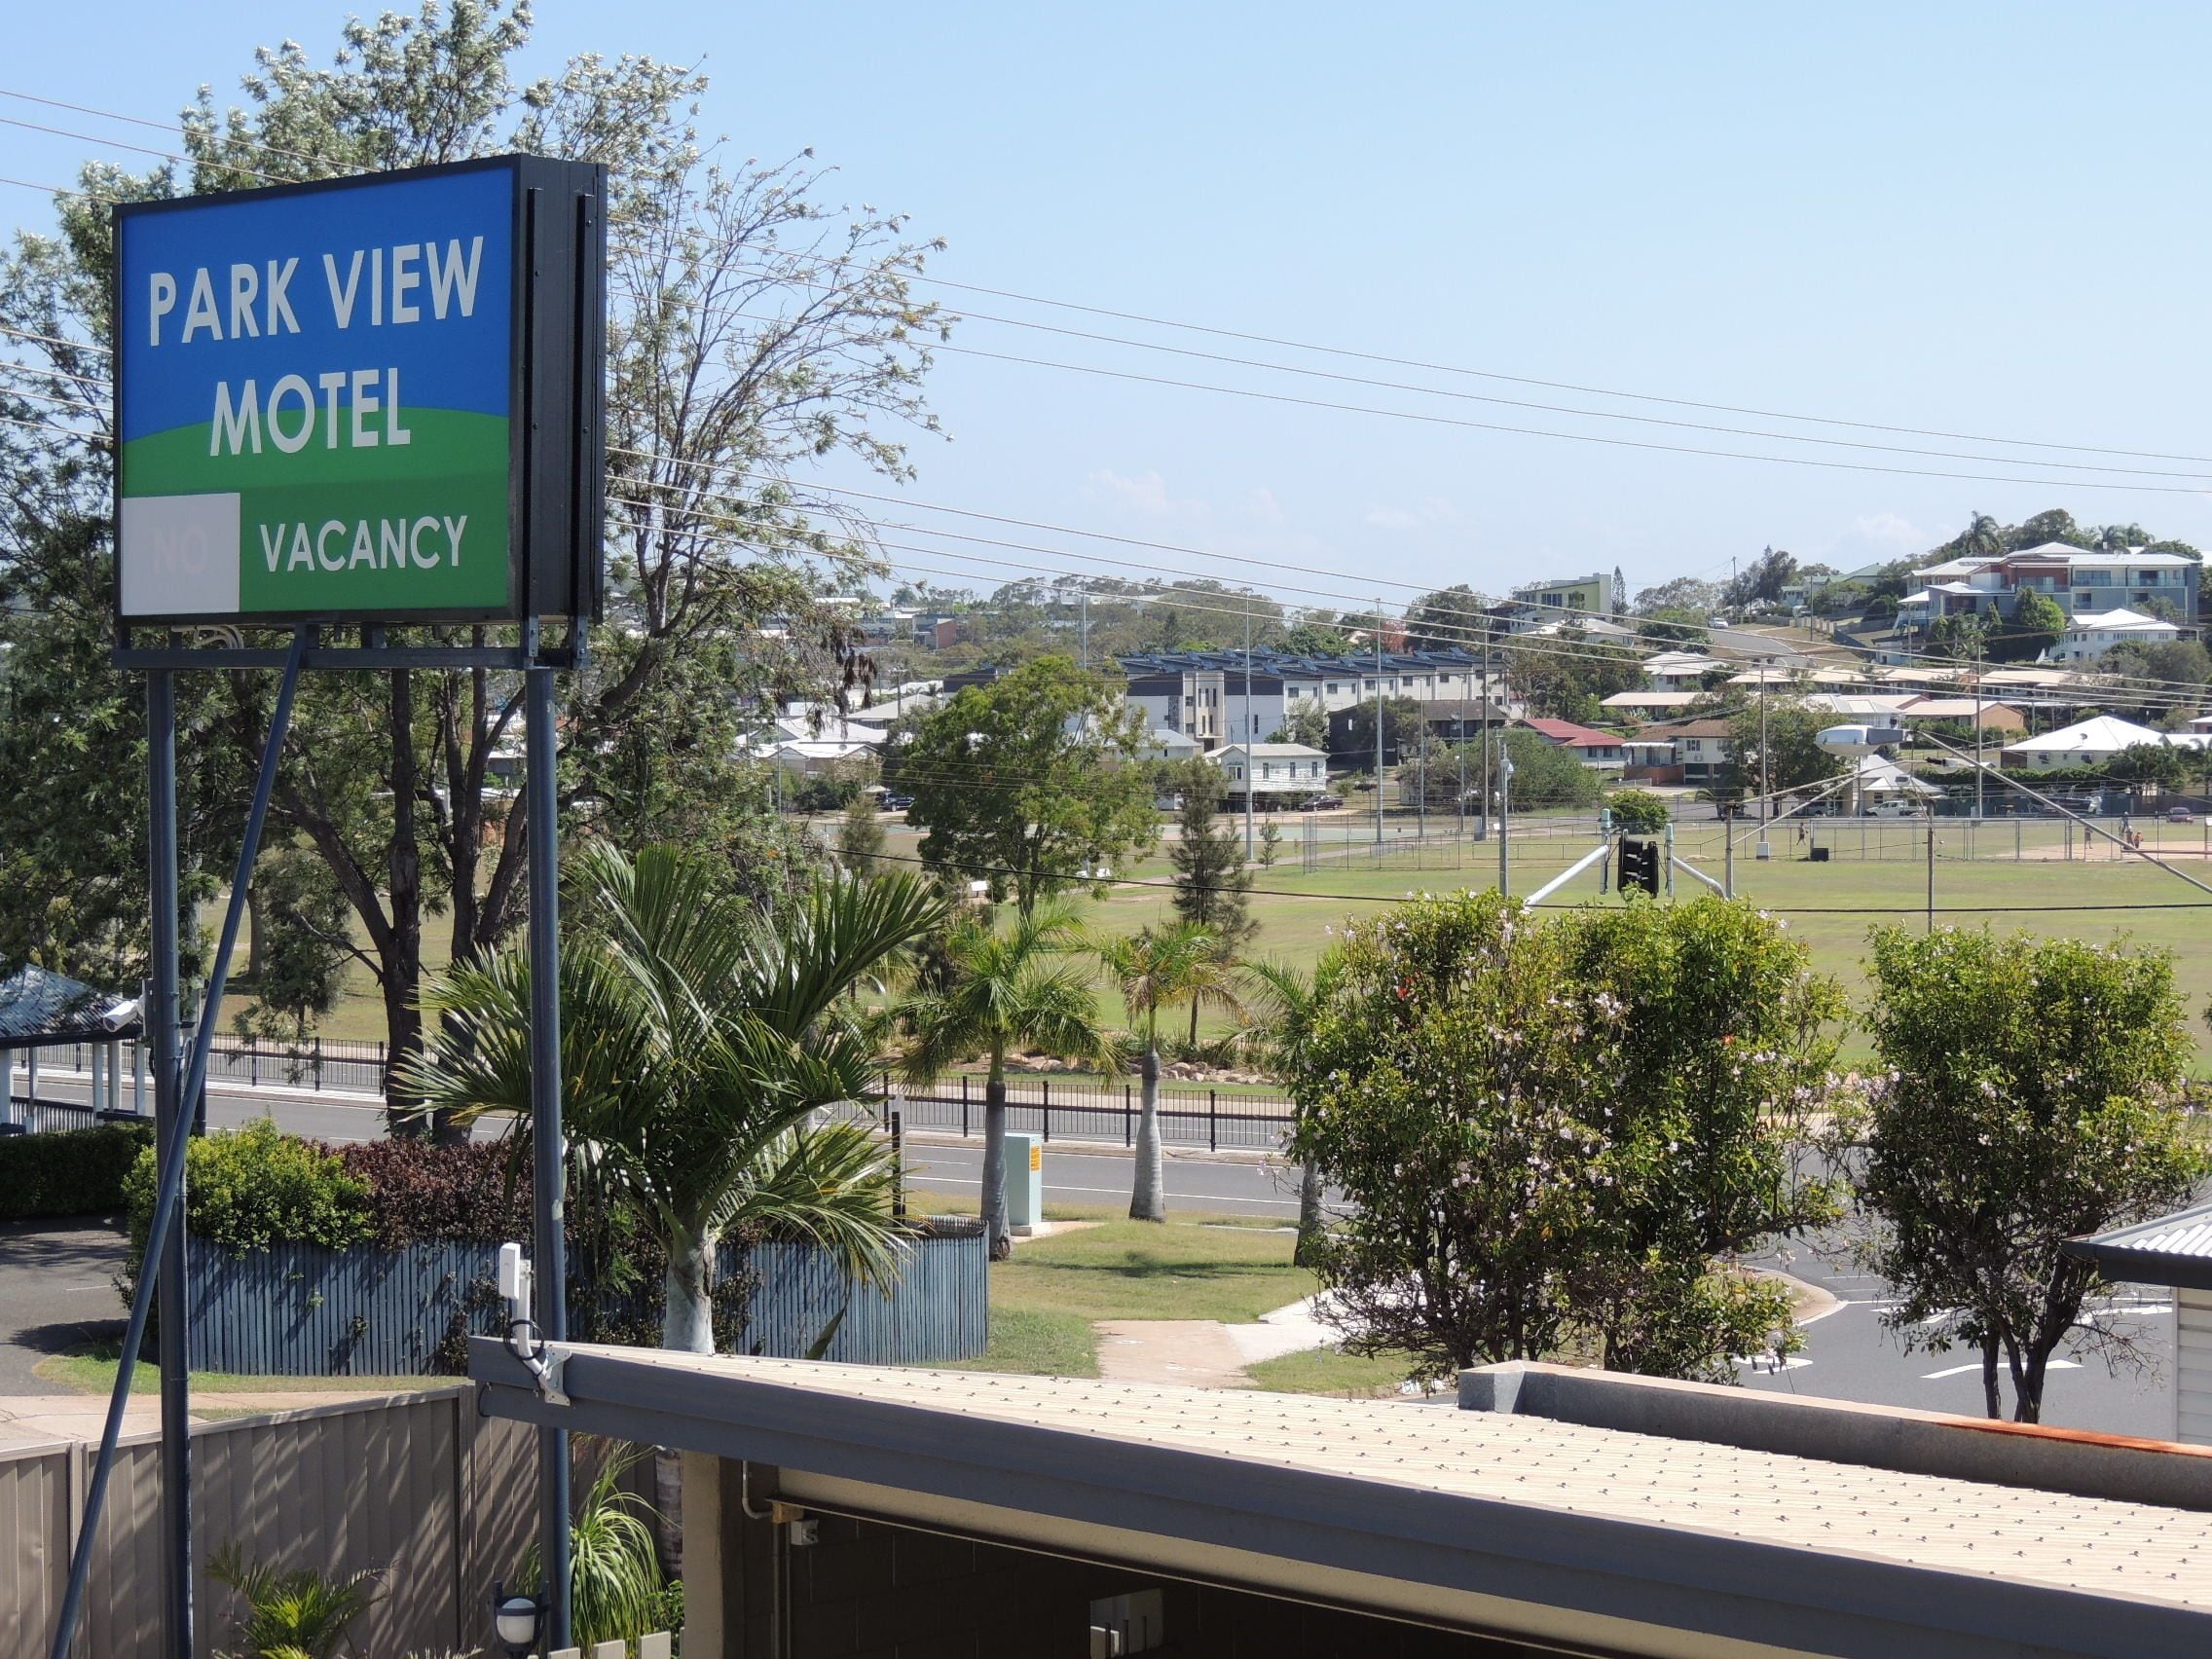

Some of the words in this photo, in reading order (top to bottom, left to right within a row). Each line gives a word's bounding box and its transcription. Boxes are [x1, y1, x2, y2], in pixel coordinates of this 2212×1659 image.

[149, 257, 301, 347] PARK
[322, 236, 484, 329] VIEW
[209, 367, 411, 457] MOTEL
[150, 525, 208, 576] NO
[260, 515, 467, 572] VACANCY
